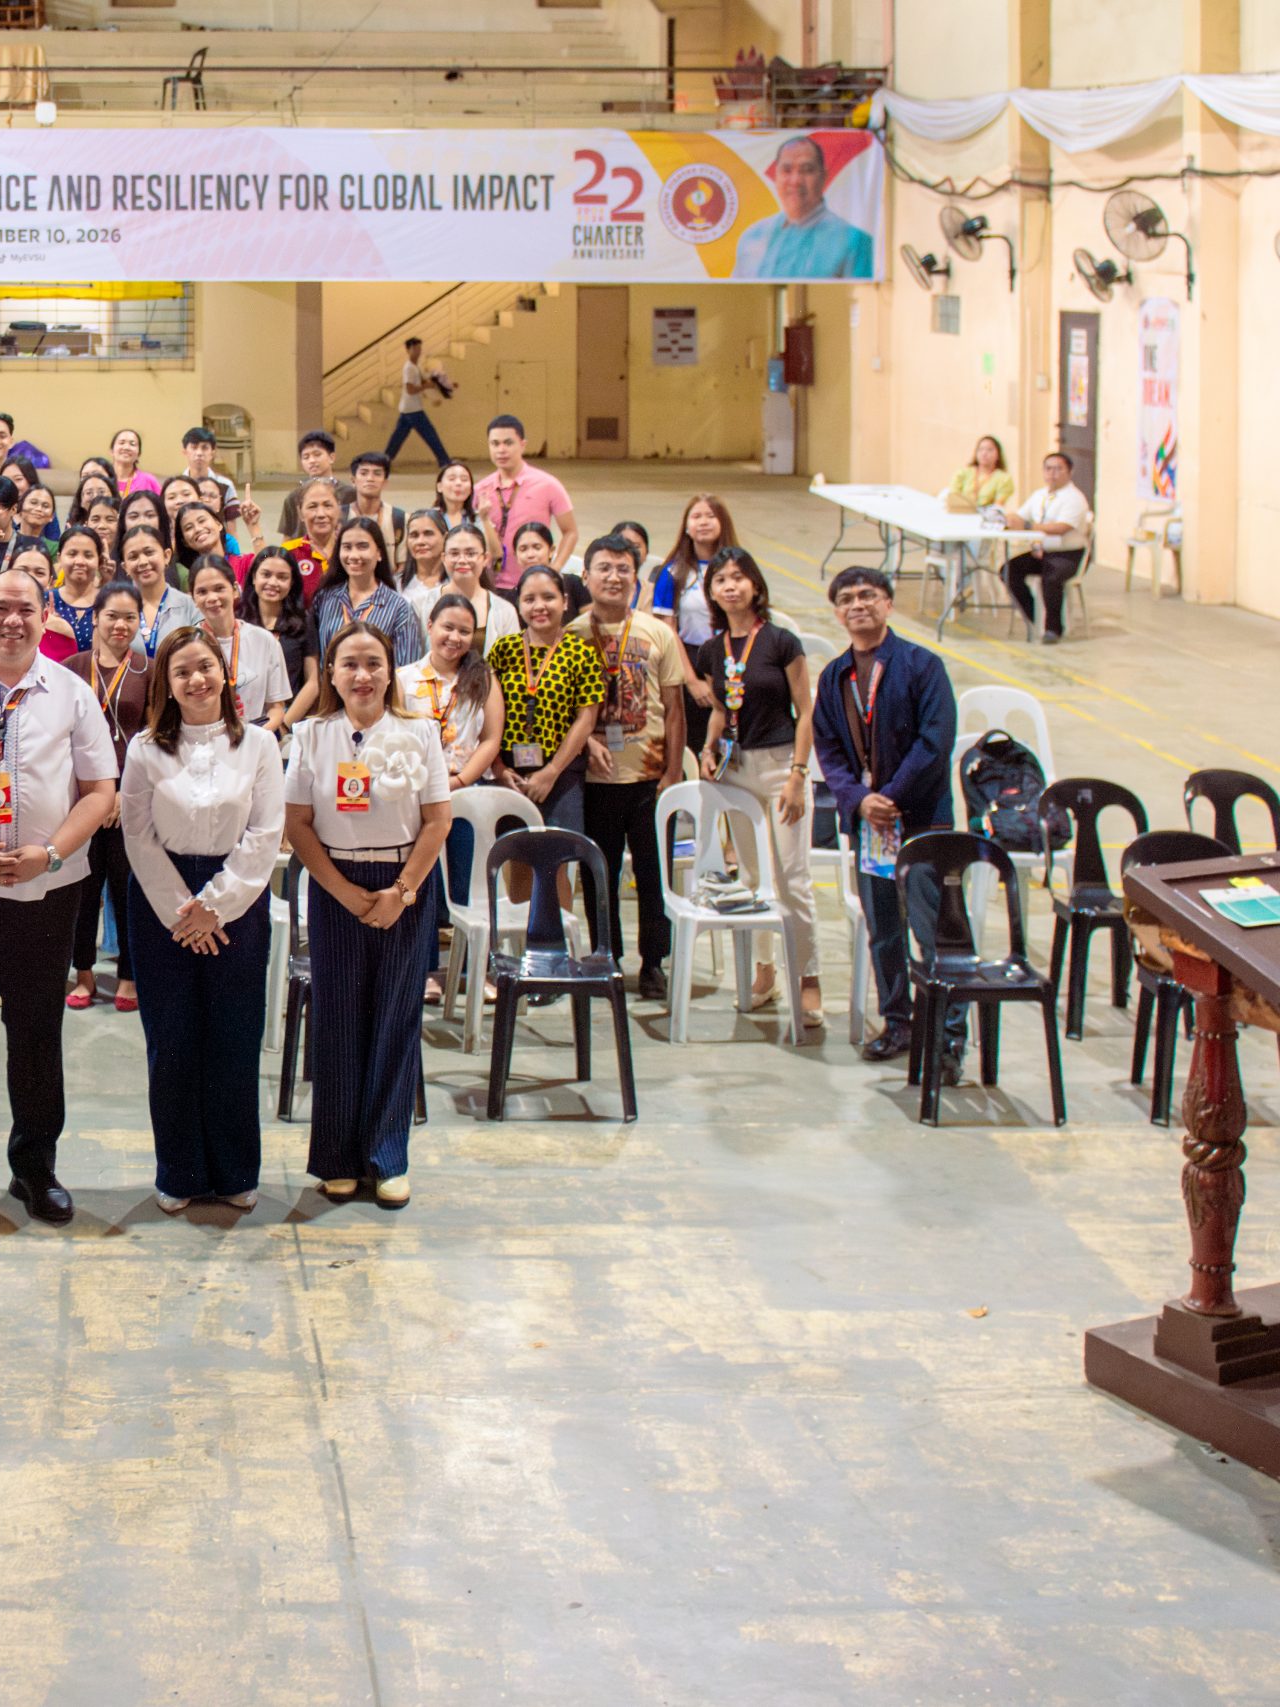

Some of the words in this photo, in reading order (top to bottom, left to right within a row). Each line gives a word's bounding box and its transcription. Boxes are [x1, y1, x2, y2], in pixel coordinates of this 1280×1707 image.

[47, 174, 102, 212] AND
[112, 173, 270, 212] RESILIENCY
[279, 173, 329, 212] FOR
[339, 173, 443, 212] GLOBAL
[452, 173, 555, 212] IMPACT
[47, 228, 71, 246] 10,
[76, 228, 122, 244] 2026
[572, 225, 644, 247] CHARTER
